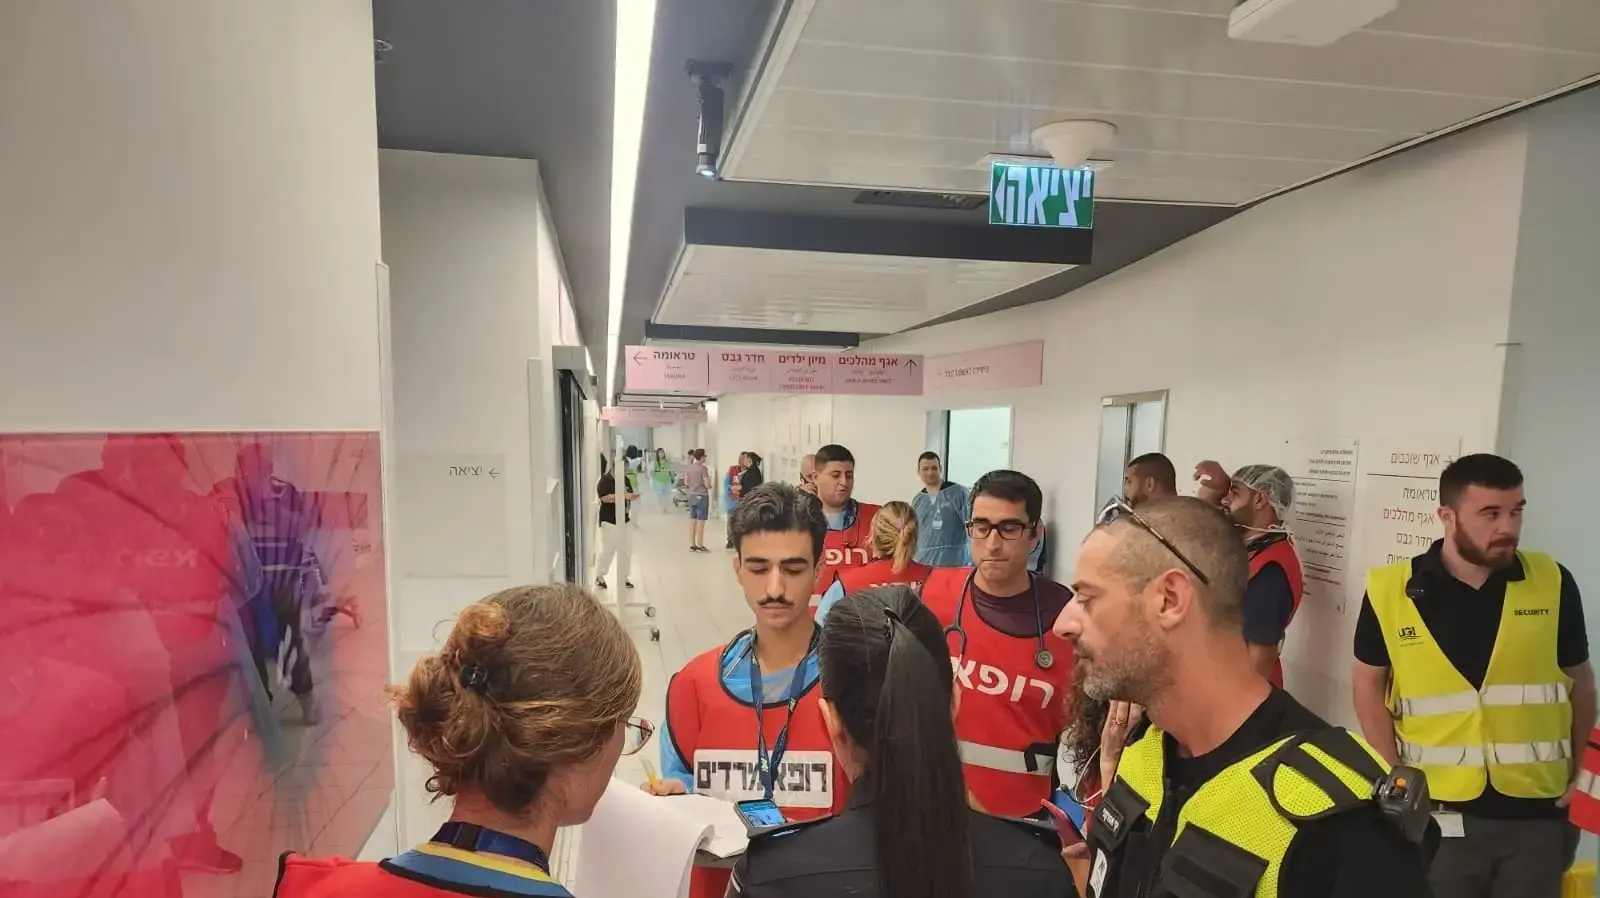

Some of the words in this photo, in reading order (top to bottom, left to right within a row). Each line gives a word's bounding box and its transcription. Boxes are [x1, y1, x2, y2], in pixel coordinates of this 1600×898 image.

[1005, 166, 1092, 226] יציאה
[653, 351, 696, 361] טראומה
[721, 353, 742, 363] גבס
[745, 353, 765, 364] חדר
[778, 353, 805, 364] ילדים
[808, 355, 826, 367] מיון
[838, 354, 876, 366] מהלכים
[879, 357, 898, 368] אגף
[1390, 453, 1421, 464] שוכבים
[1423, 454, 1440, 468] אגף
[449, 465, 482, 476] יציאה
[1402, 487, 1437, 500] טראומה
[1383, 507, 1415, 522] מהלכים
[1417, 511, 1435, 527] אגף
[1396, 532, 1413, 545] גבס
[1415, 535, 1433, 548] חדר
[825, 547, 868, 565] רופ
[950, 653, 1055, 709] רופא
